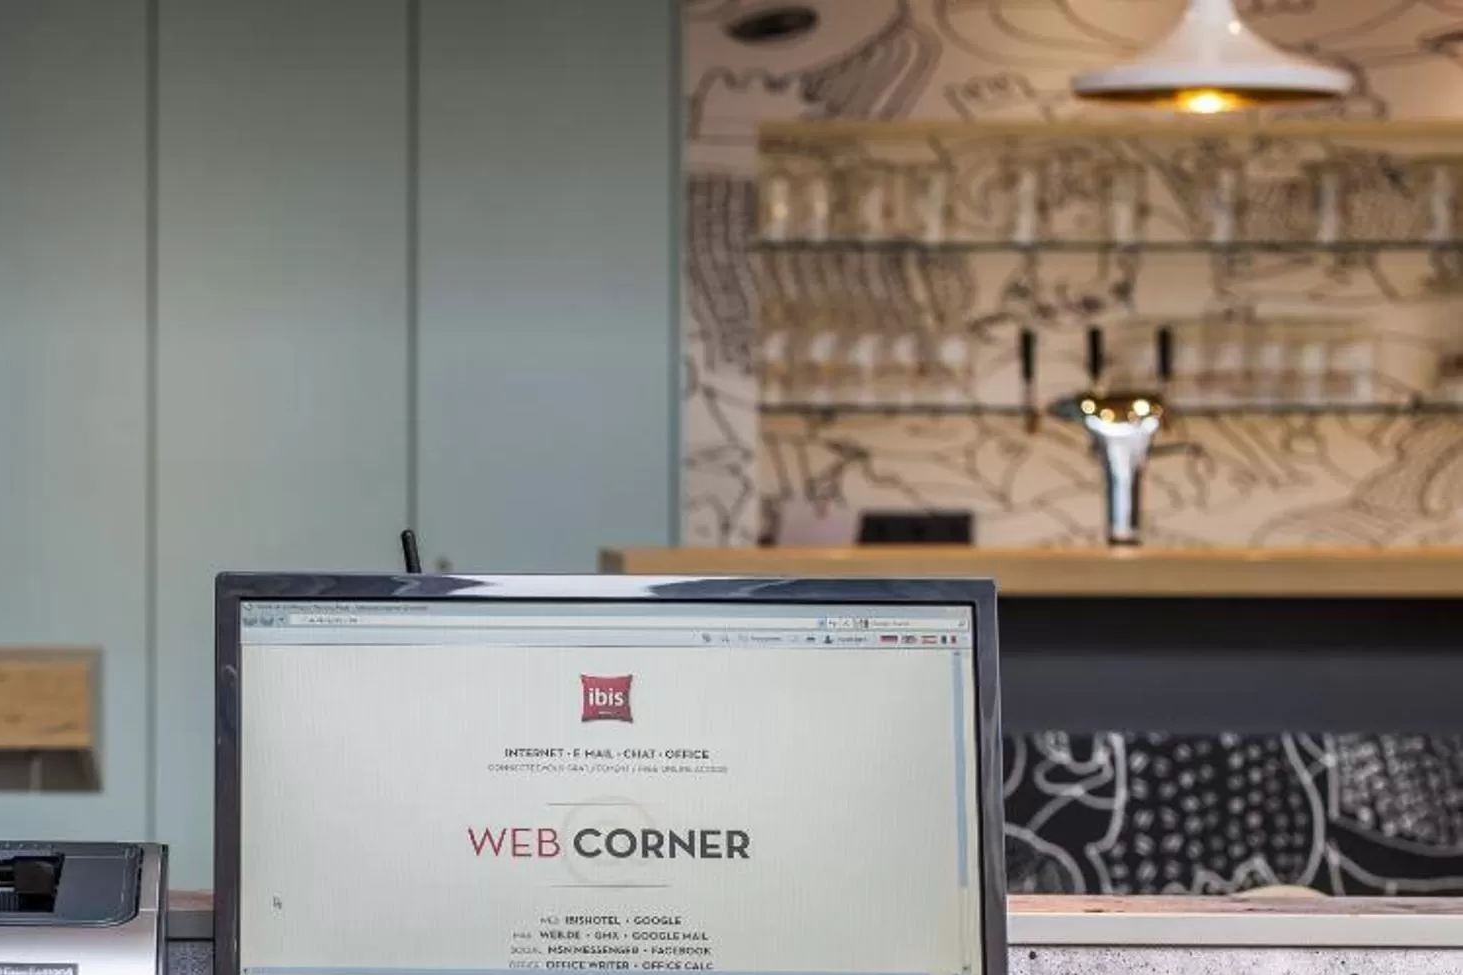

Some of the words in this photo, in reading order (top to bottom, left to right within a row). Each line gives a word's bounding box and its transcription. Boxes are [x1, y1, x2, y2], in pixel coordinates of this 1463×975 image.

[588, 687, 625, 706] ibis
[623, 748, 656, 759] CHAT
[665, 749, 710, 760] OFFICE
[467, 827, 561, 858] WEB
[572, 828, 751, 860] CORNER
[633, 916, 682, 926] GOOGLE
[632, 931, 679, 941] GOOGLE
